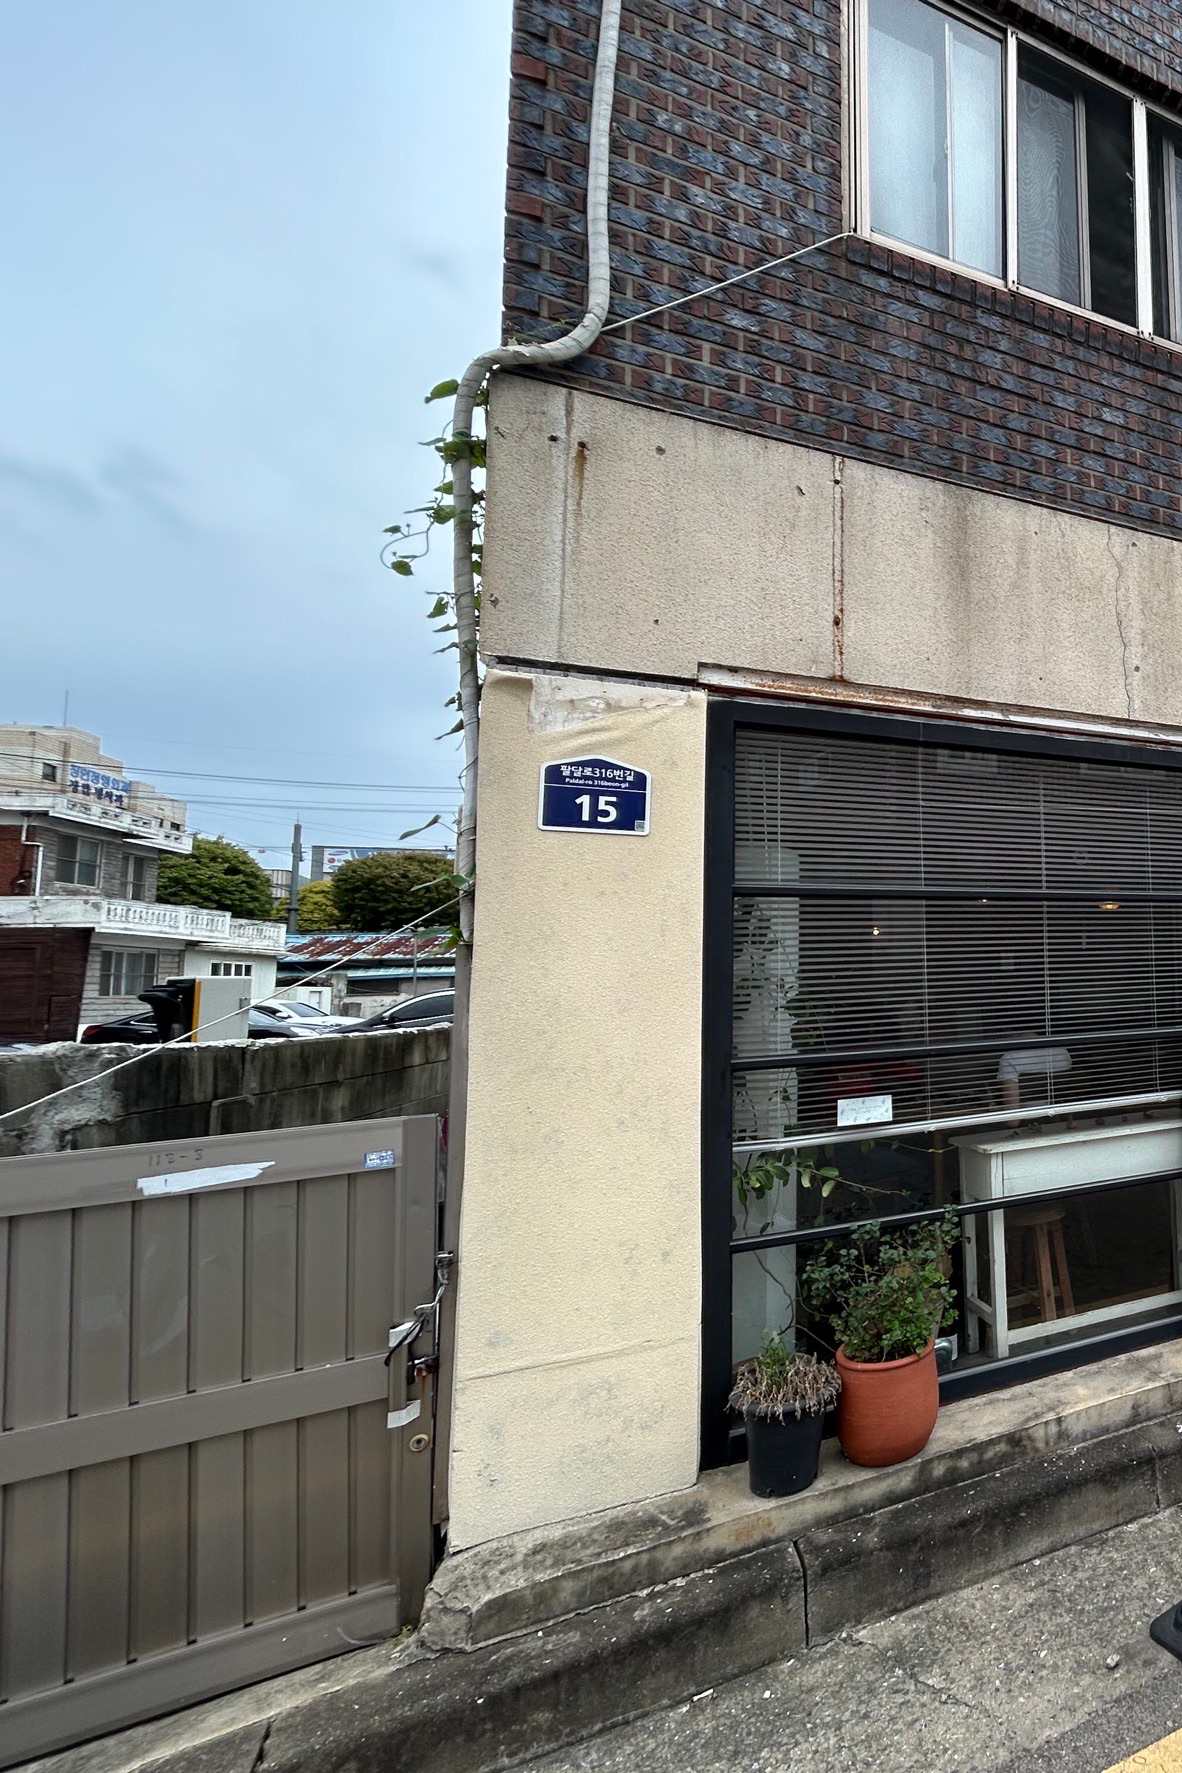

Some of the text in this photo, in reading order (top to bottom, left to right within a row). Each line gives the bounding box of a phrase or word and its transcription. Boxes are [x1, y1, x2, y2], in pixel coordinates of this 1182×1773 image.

[560, 764, 634, 782] 팔달로316번길
[565, 777, 629, 788] Paldal-ro 316beon-gil
[574, 794, 618, 823] 15
